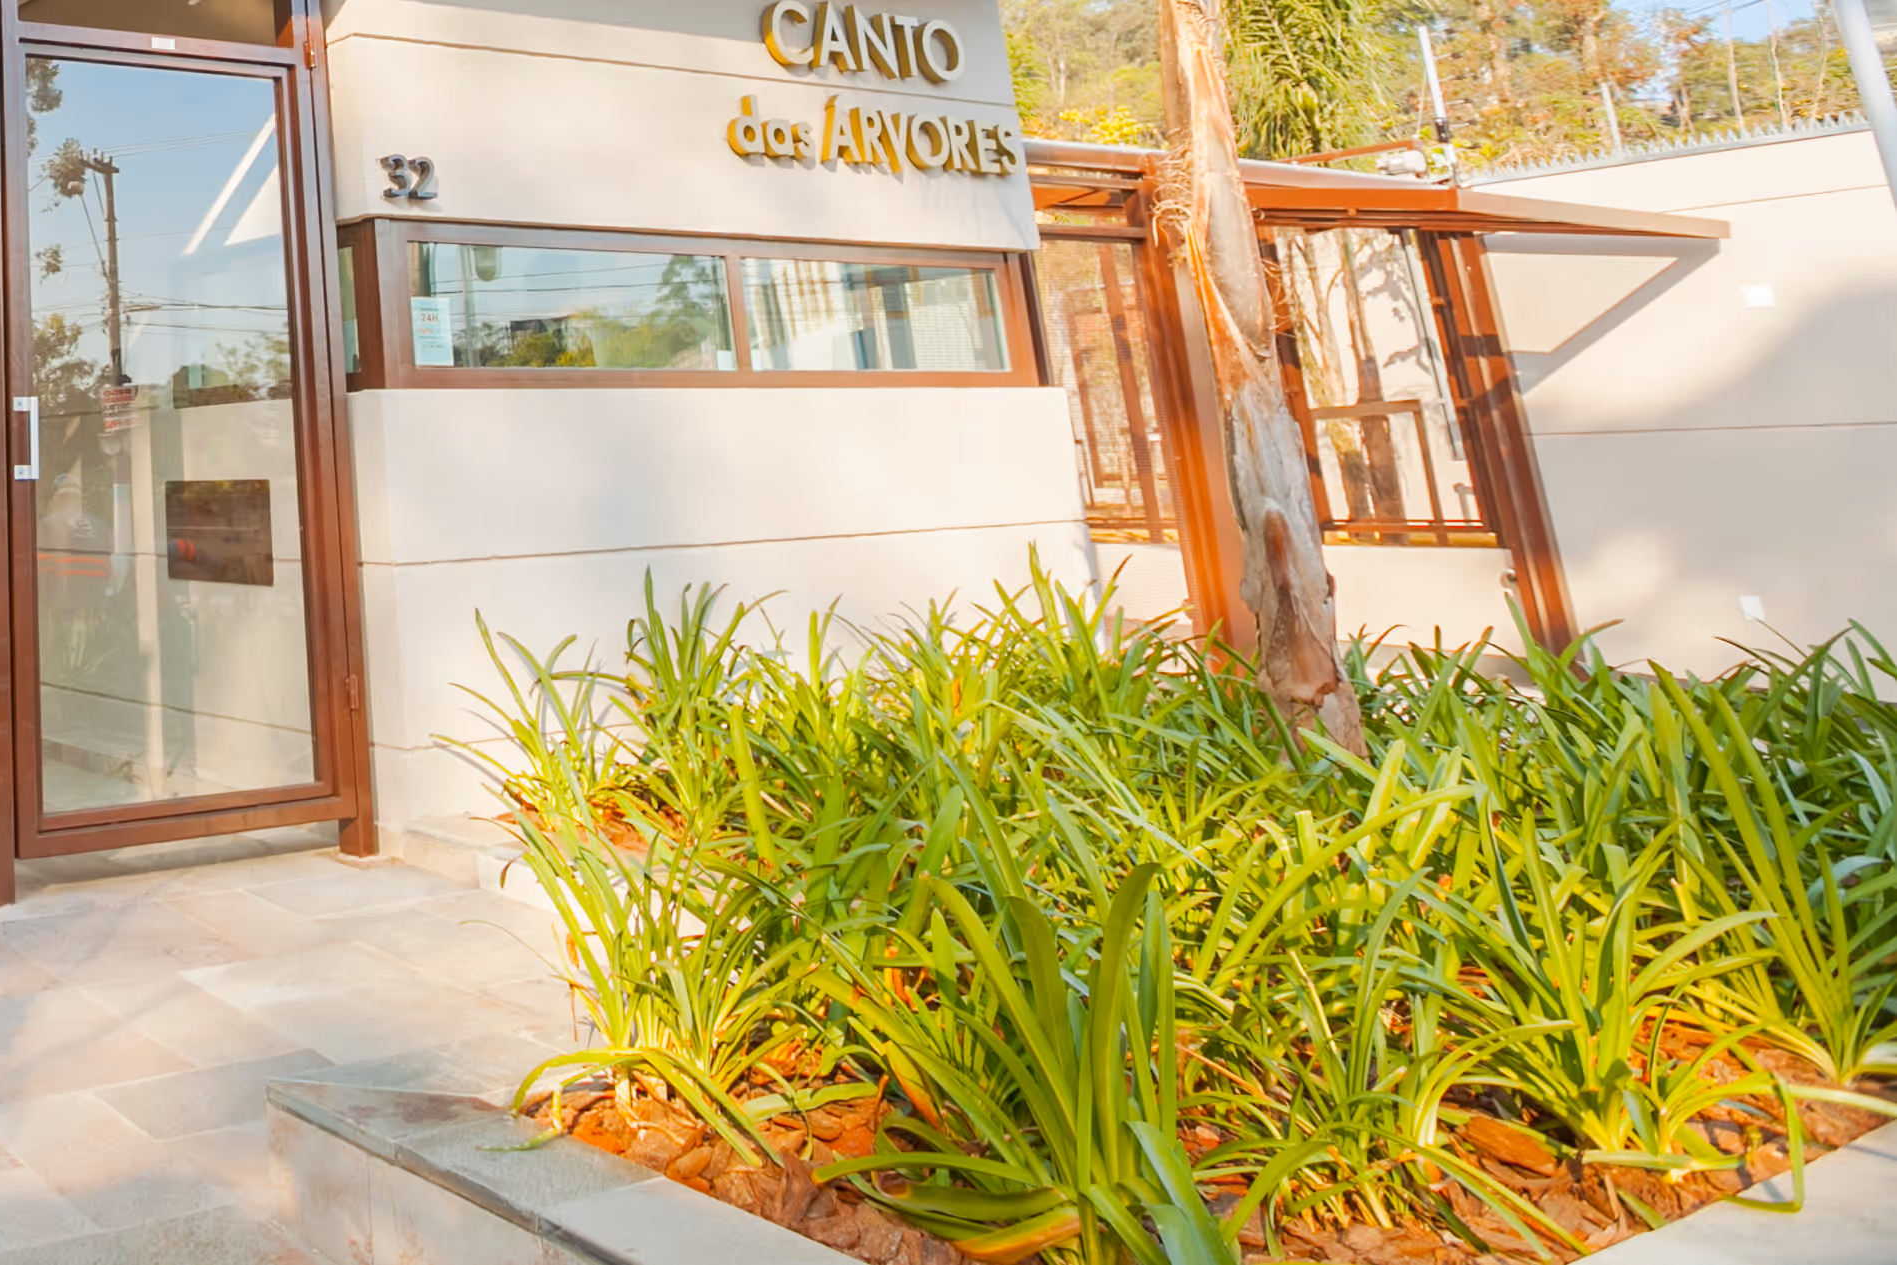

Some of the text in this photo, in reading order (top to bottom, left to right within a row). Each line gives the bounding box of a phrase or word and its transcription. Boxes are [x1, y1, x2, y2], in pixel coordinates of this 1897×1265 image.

[727, 93, 1020, 176] das ÁRVORES
[379, 153, 439, 200] 32
